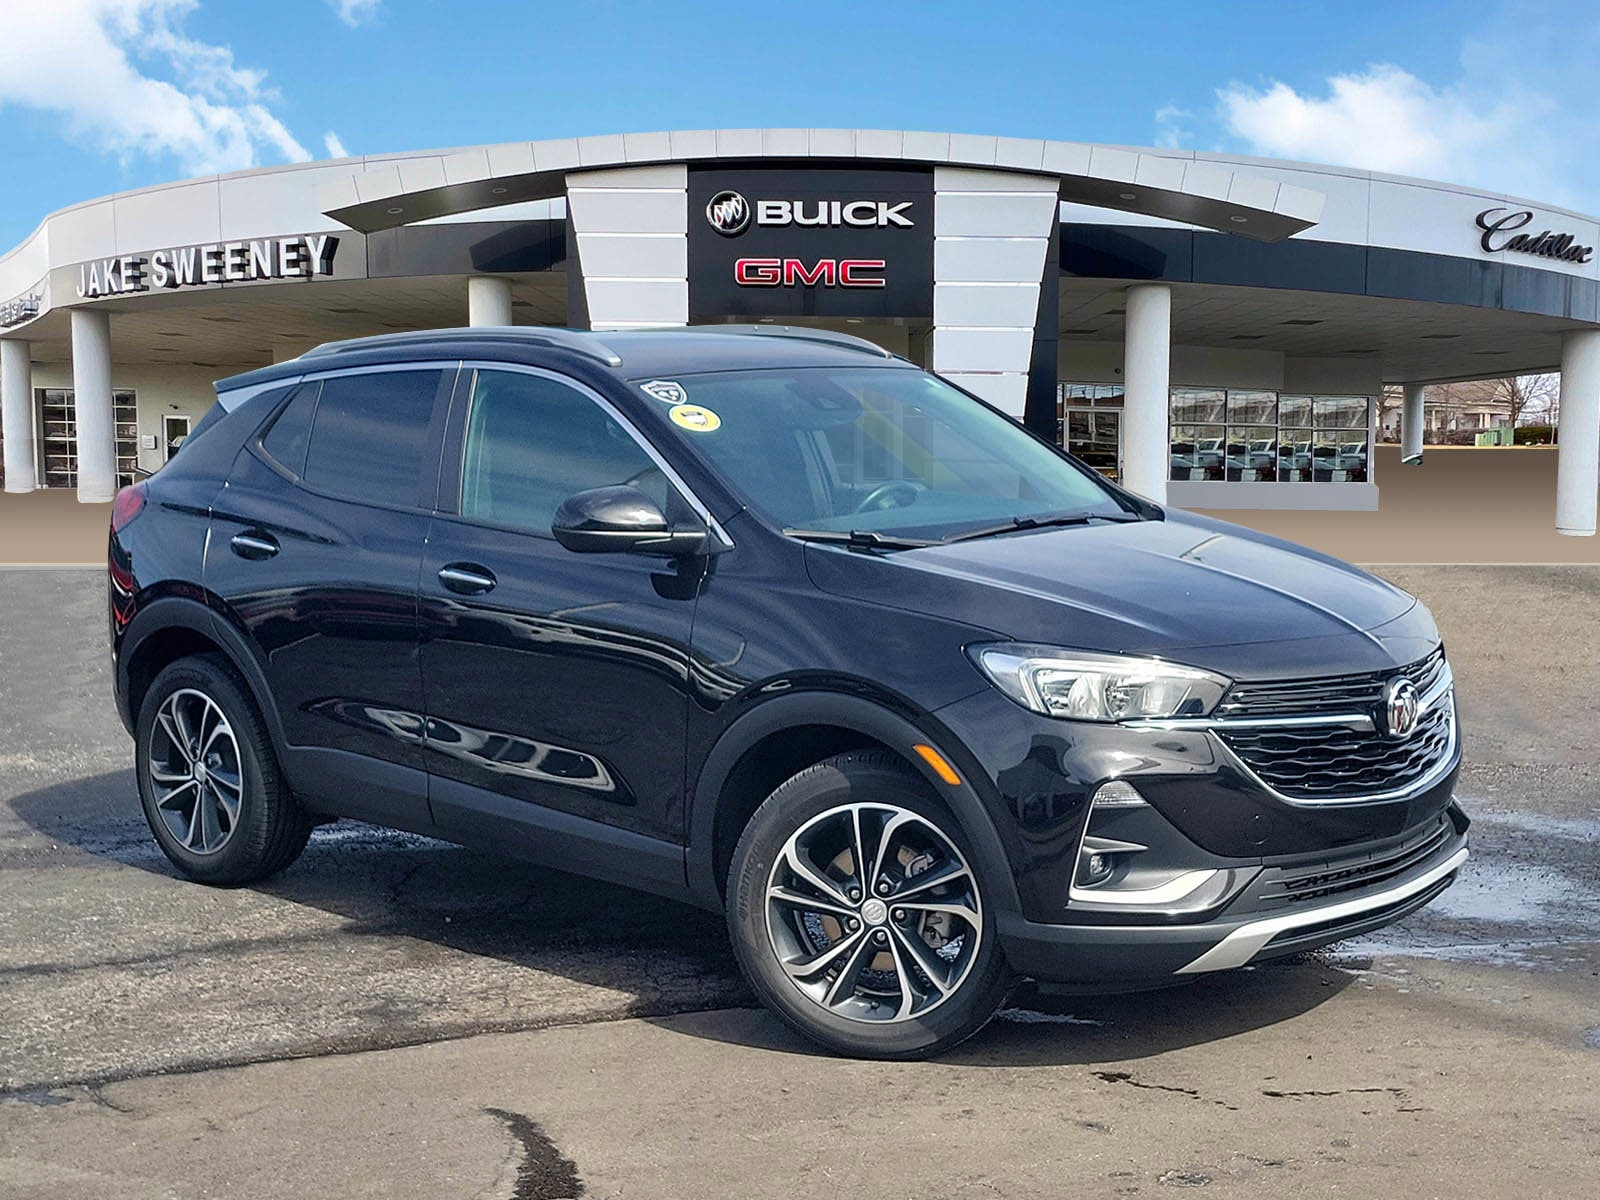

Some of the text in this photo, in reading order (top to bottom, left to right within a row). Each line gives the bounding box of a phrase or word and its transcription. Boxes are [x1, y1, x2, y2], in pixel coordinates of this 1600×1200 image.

[757, 200, 915, 226] BUICK
[1475, 207, 1593, 264] Cadillac
[76, 235, 332, 298] JAKE SWEENEY
[735, 258, 886, 287] GMC
